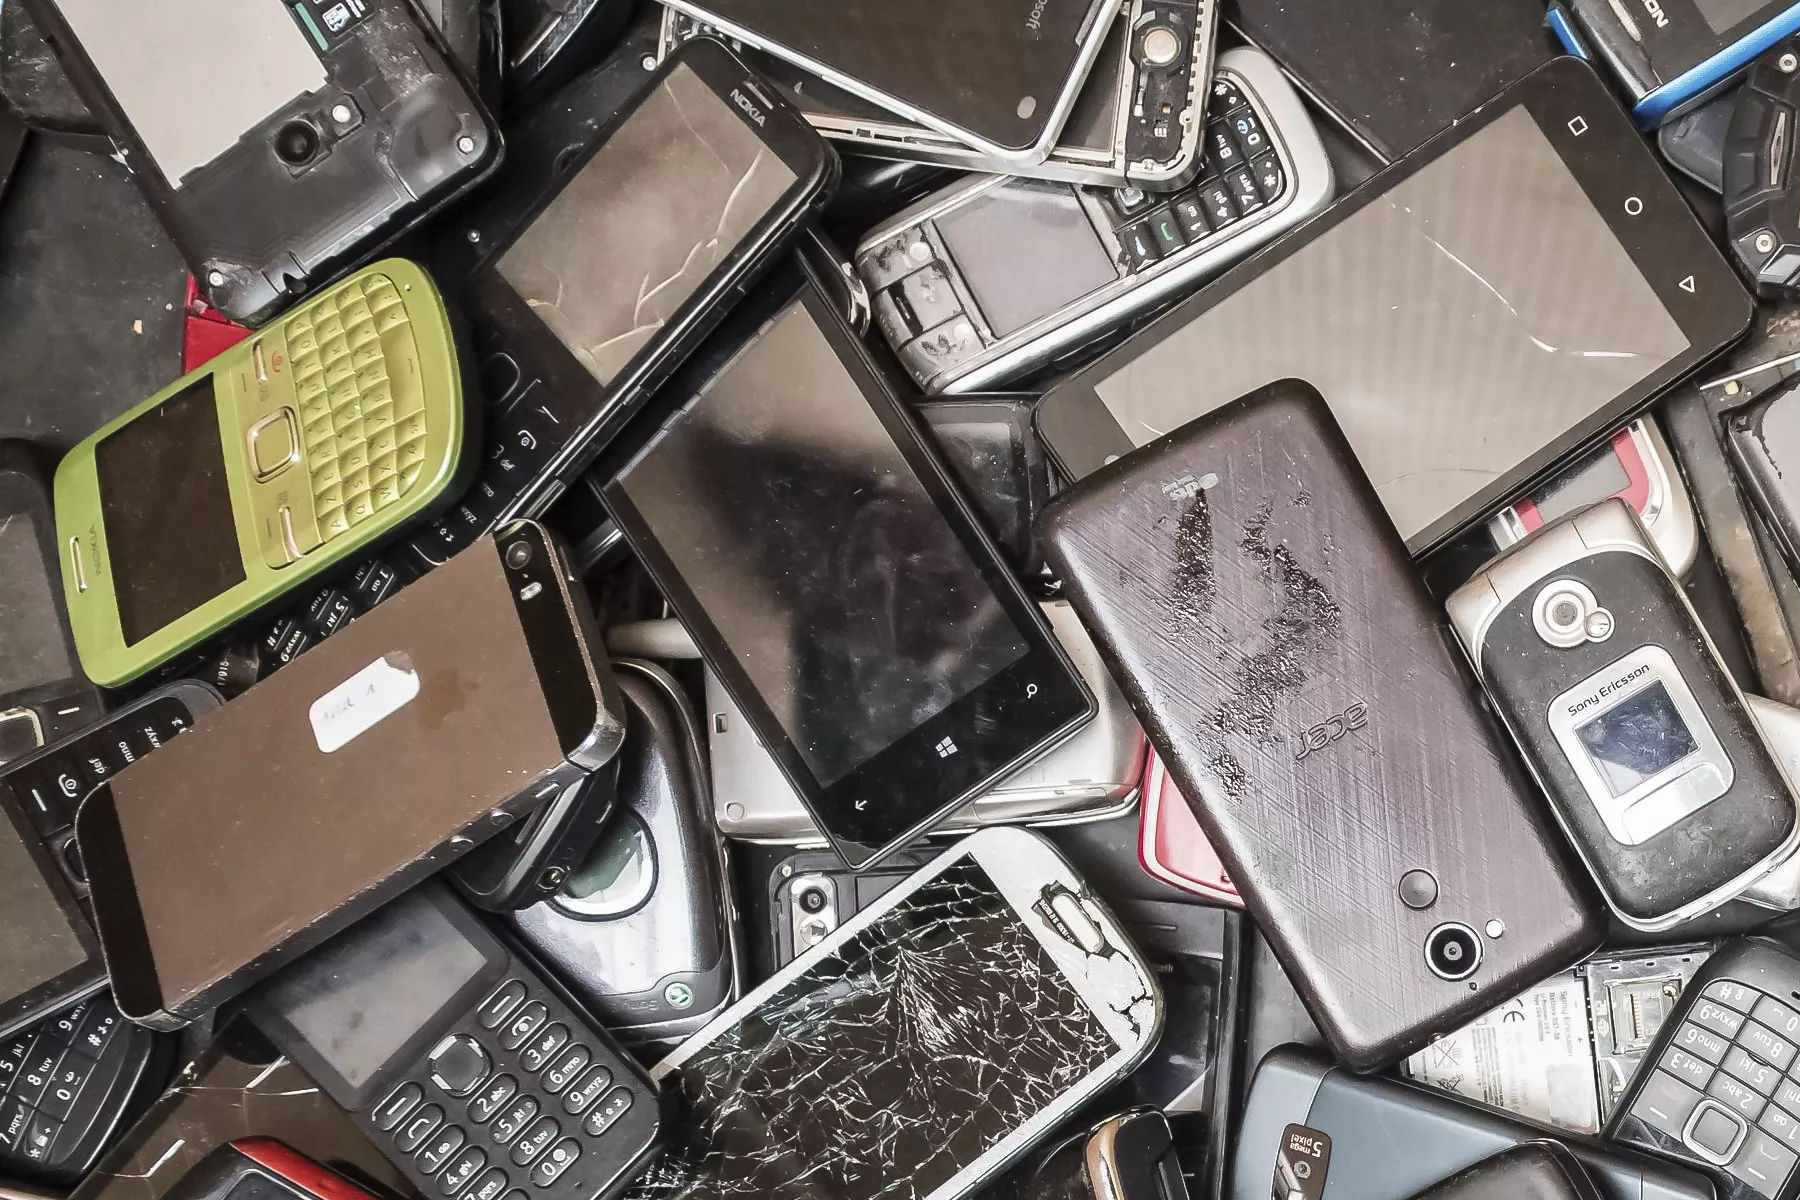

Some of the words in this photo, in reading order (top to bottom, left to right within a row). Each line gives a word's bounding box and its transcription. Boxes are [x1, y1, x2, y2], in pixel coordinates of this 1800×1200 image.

[730, 88, 765, 128] NOKIA
[1568, 694, 1600, 717] Sony
[1600, 663, 1650, 698] Ericsson
[1296, 702, 1368, 761] acer
[1290, 1142, 1311, 1155] mega
[1291, 1133, 1312, 1146] pixel
[1311, 1141, 1323, 1158] 5
